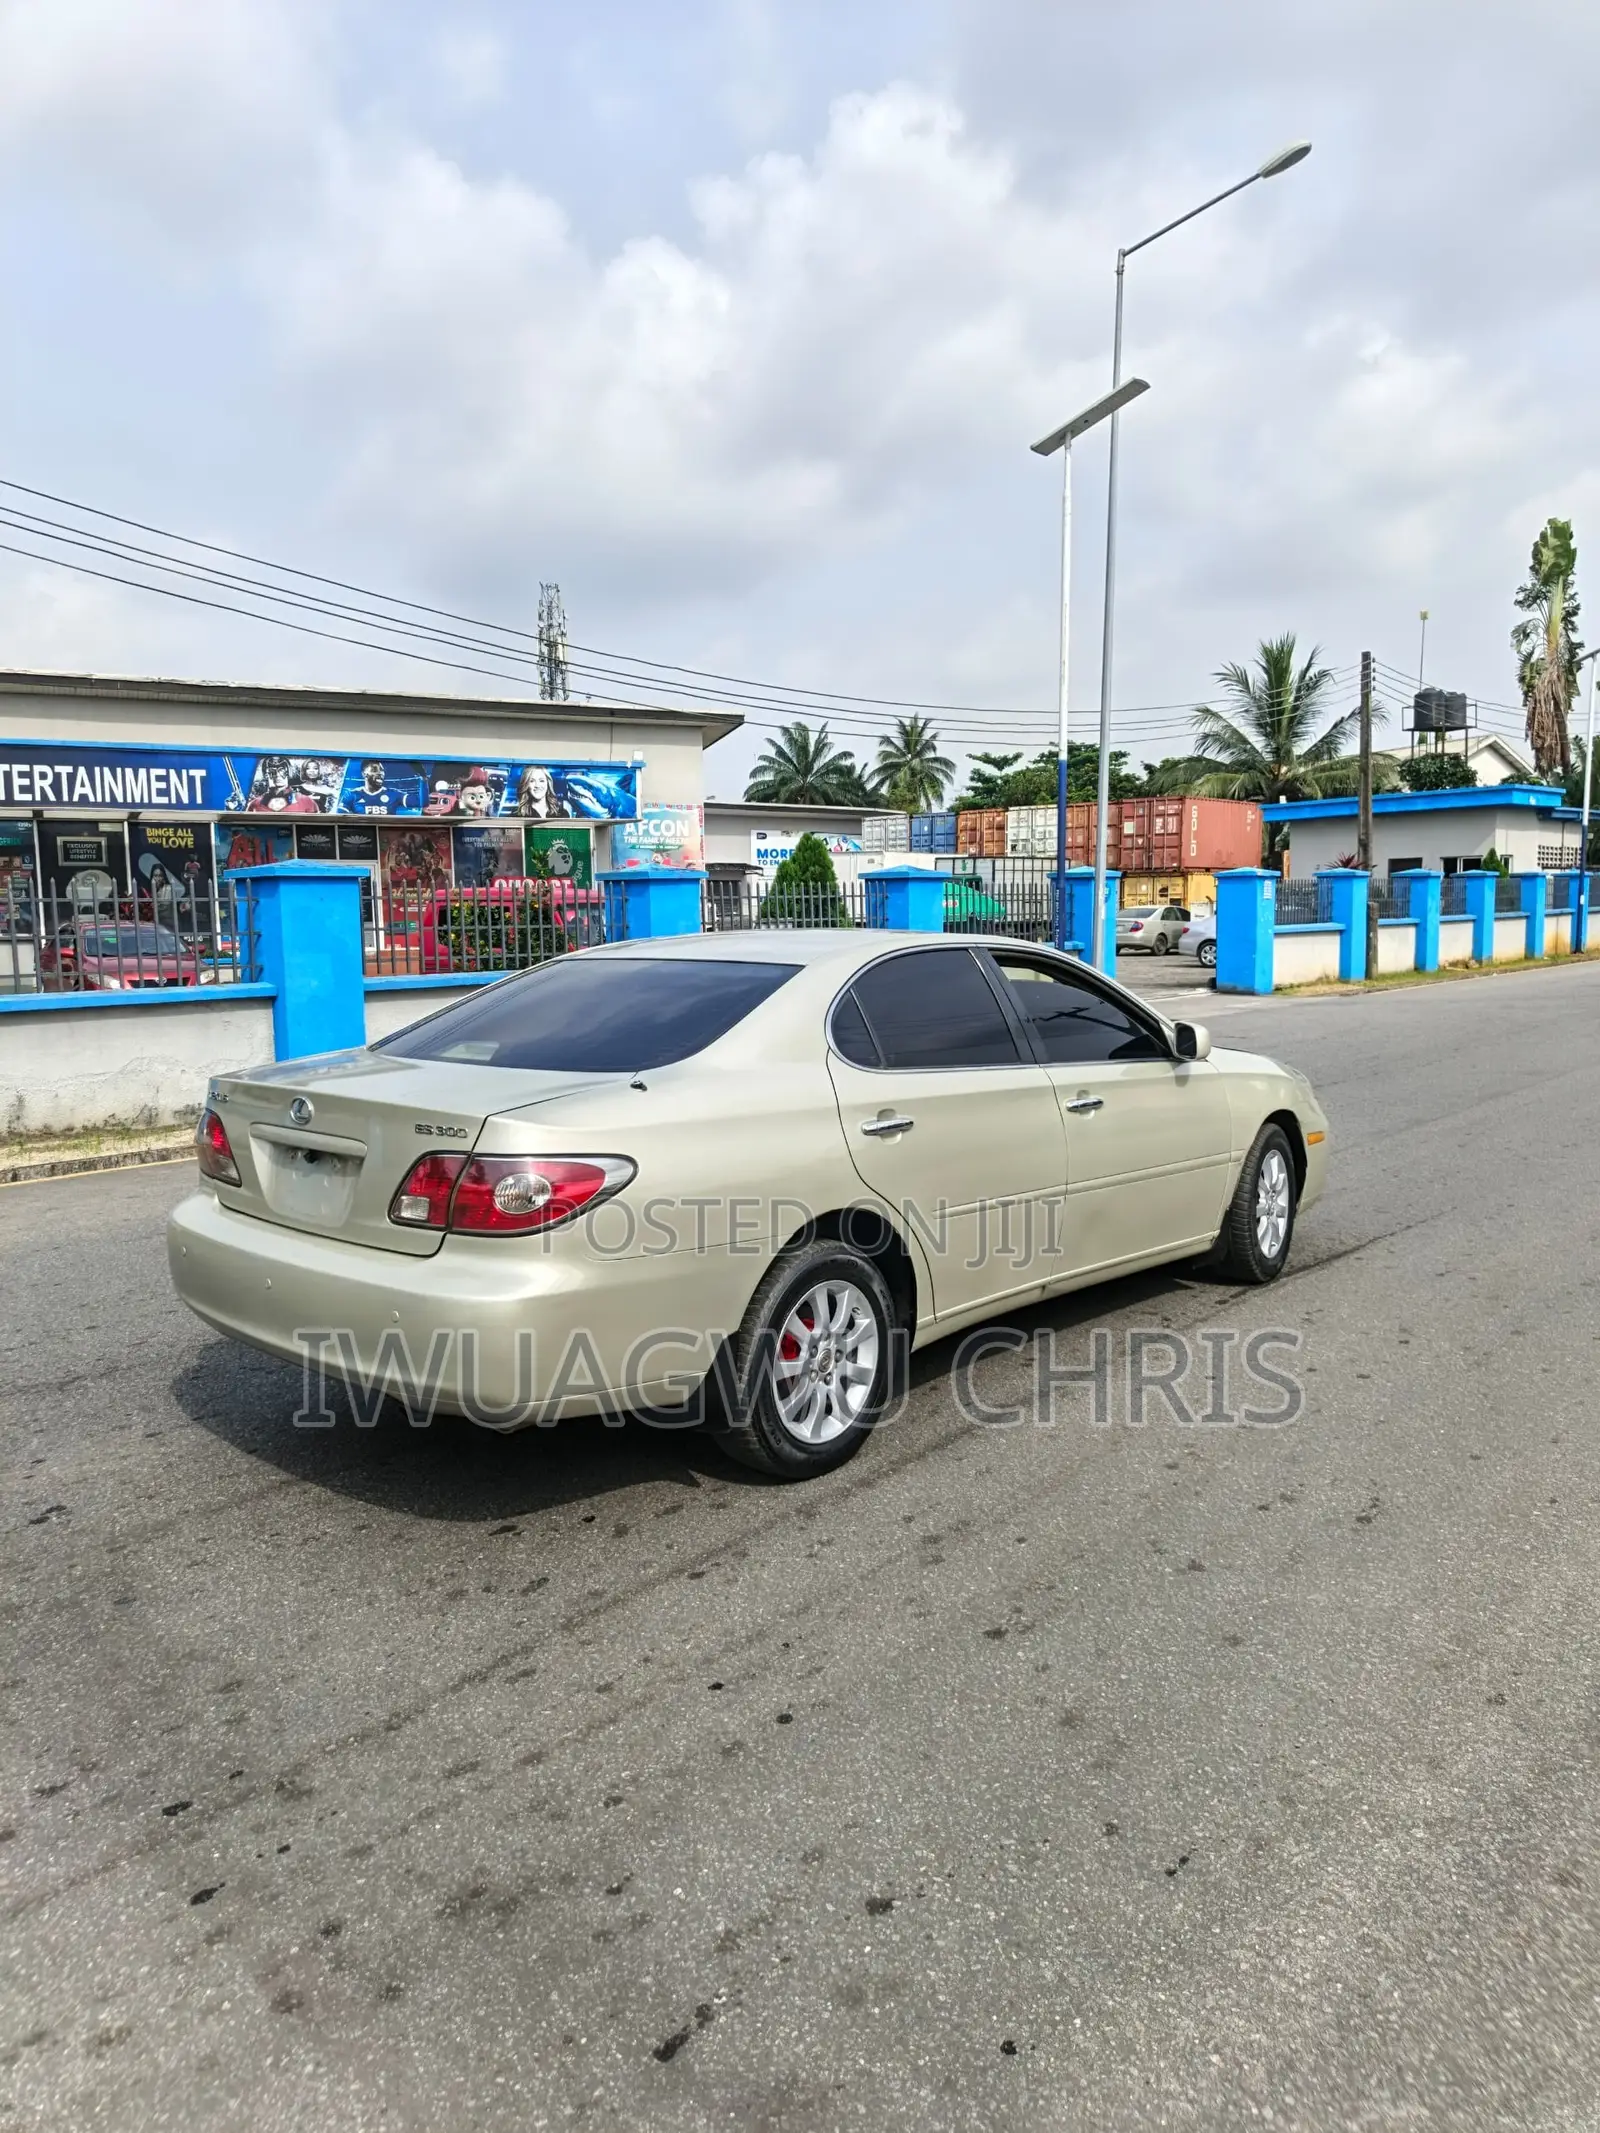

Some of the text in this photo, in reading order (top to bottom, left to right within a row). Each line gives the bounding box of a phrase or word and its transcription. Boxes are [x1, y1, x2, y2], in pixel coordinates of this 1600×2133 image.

[365, 806, 388, 815] FBS
[146, 827, 194, 837] BINGE ALL
[623, 819, 689, 836] AFCON
[162, 838, 194, 849] LOVE
[415, 1124, 468, 1138] ES 300
